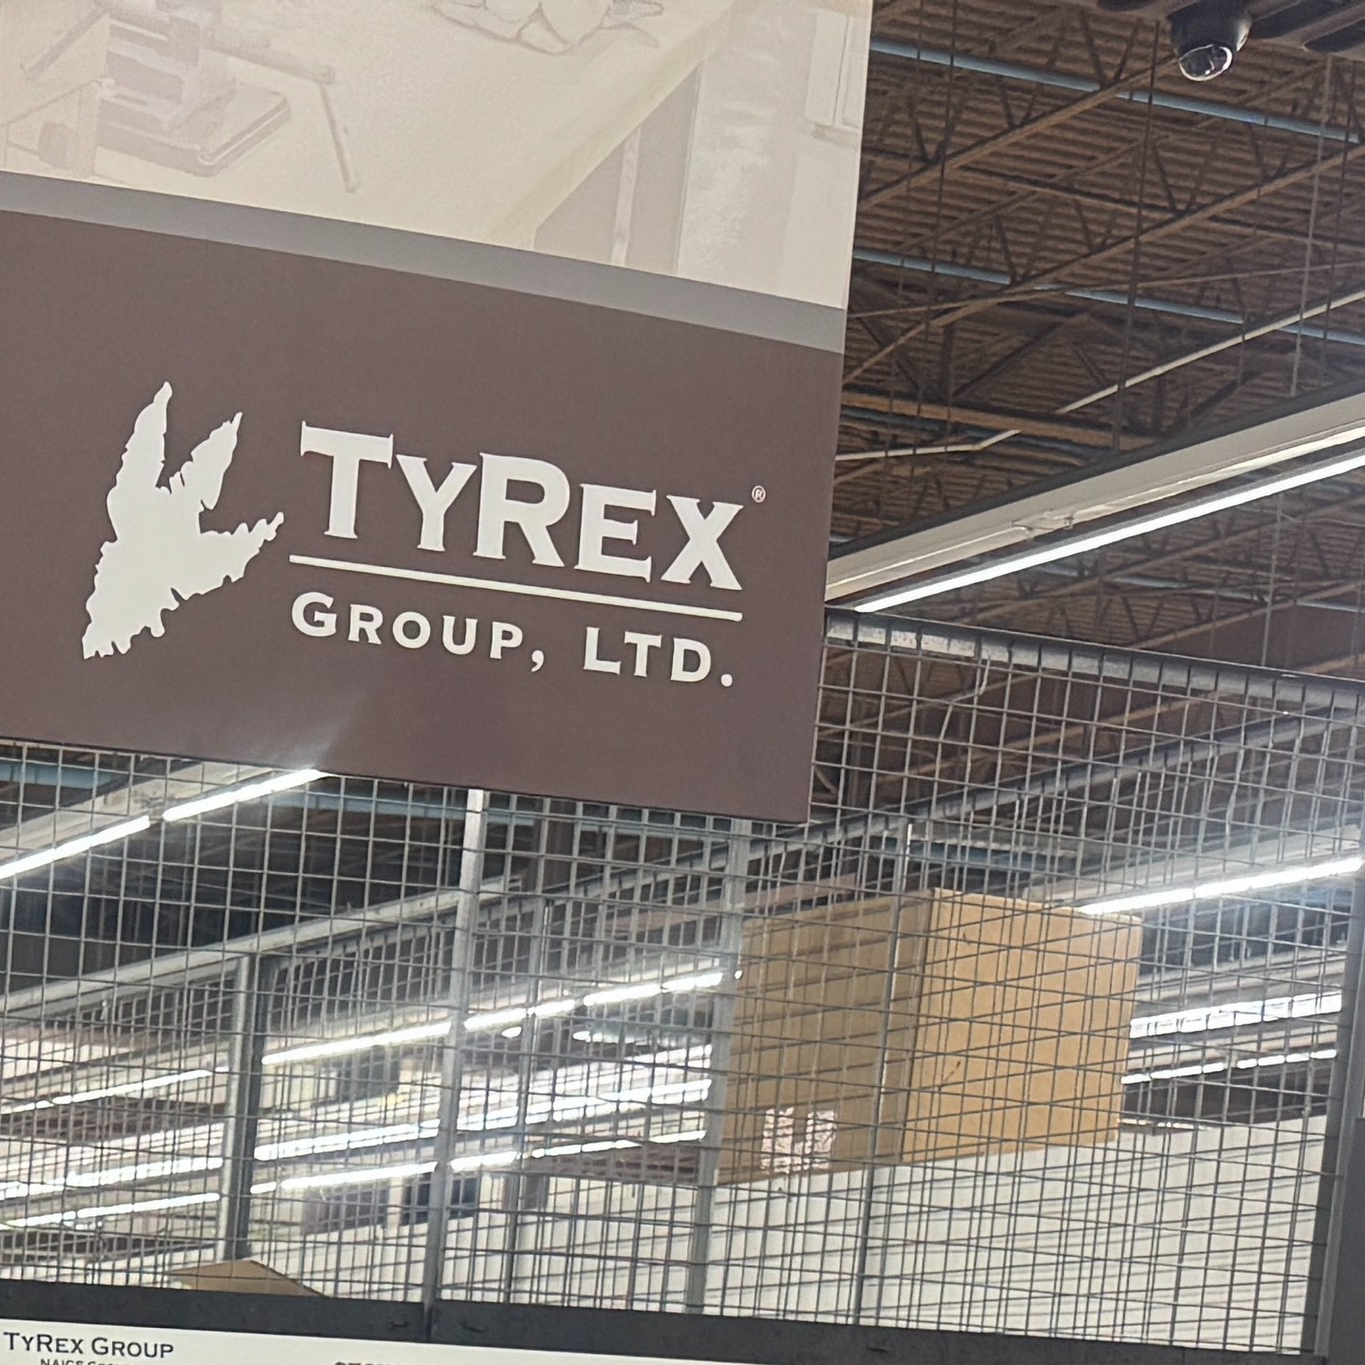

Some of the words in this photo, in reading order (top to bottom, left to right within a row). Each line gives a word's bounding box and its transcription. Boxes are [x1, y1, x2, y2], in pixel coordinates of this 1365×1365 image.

[291, 591, 545, 672] GROUP,
[582, 626, 734, 686] LTD.
[91, 1336, 175, 1358] GROUP
